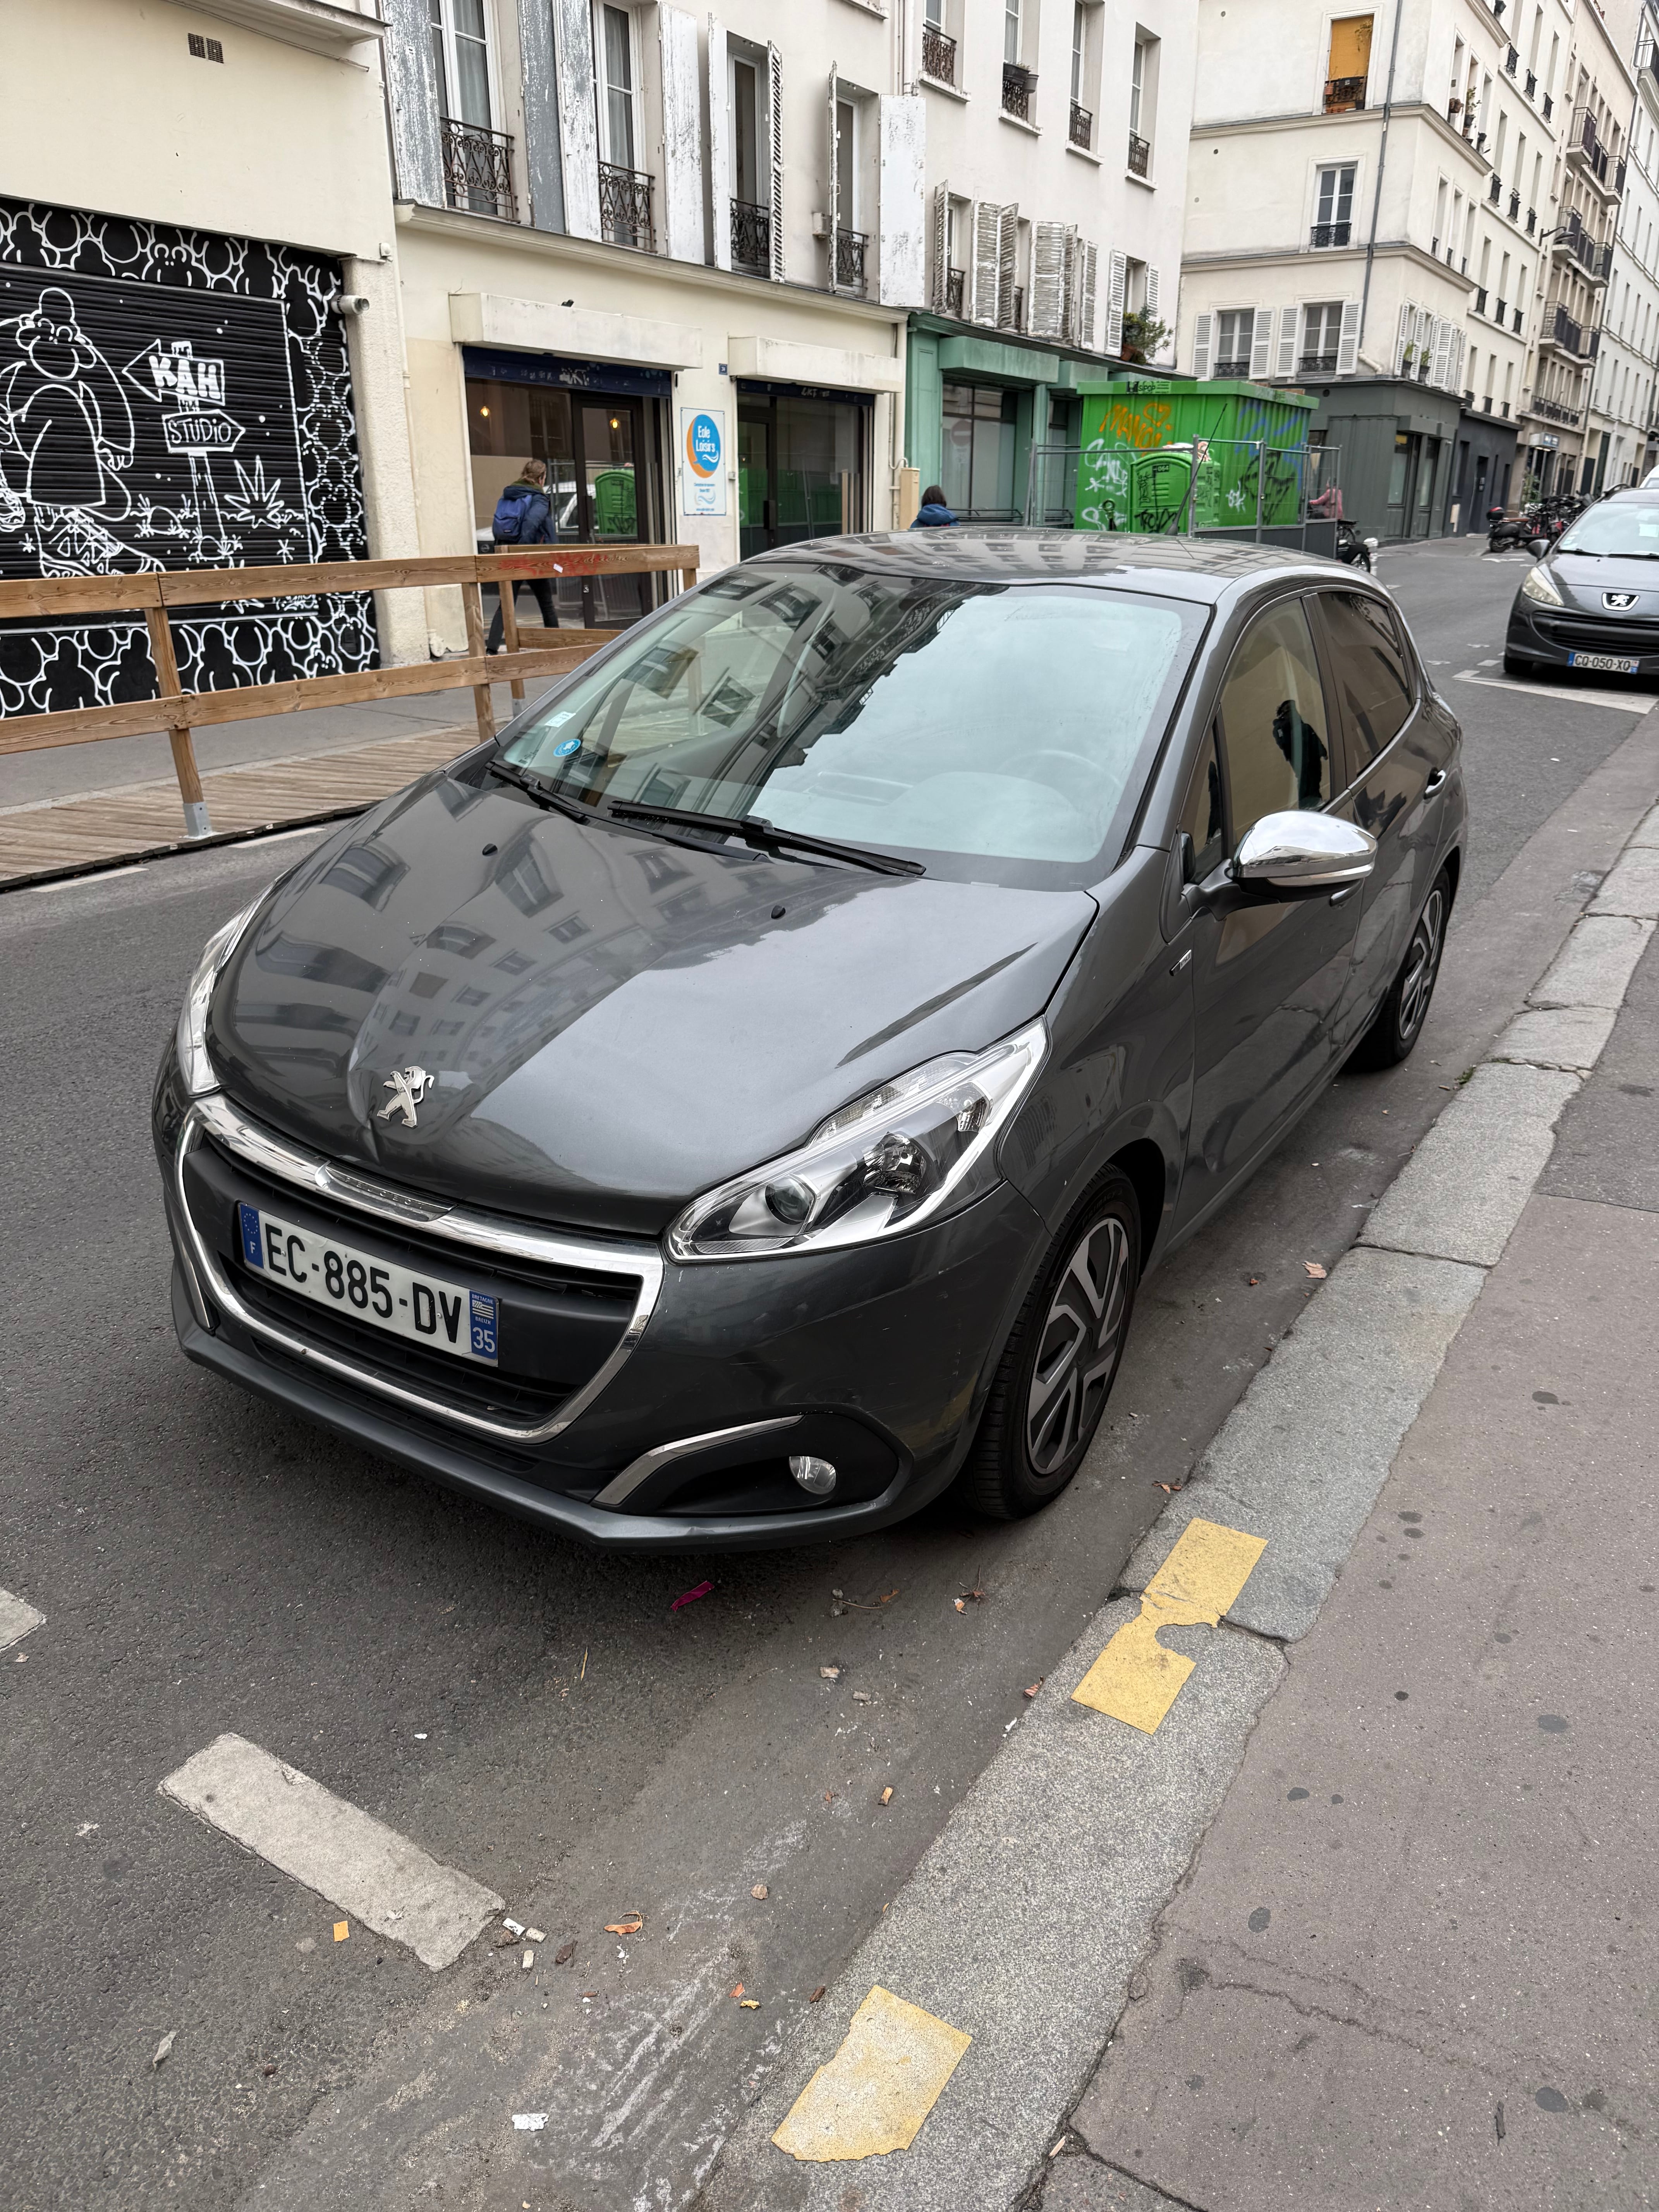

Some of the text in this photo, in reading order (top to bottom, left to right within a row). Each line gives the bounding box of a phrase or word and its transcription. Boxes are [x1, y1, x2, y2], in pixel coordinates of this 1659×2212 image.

[149, 356, 221, 399] KAH
[696, 439, 716, 453] Loisirs
[250, 1241, 256, 1254] F
[265, 1223, 461, 1343] EC-885-DV
[472, 1293, 494, 1305] BRETAGNE
[473, 1327, 495, 1353] 35
